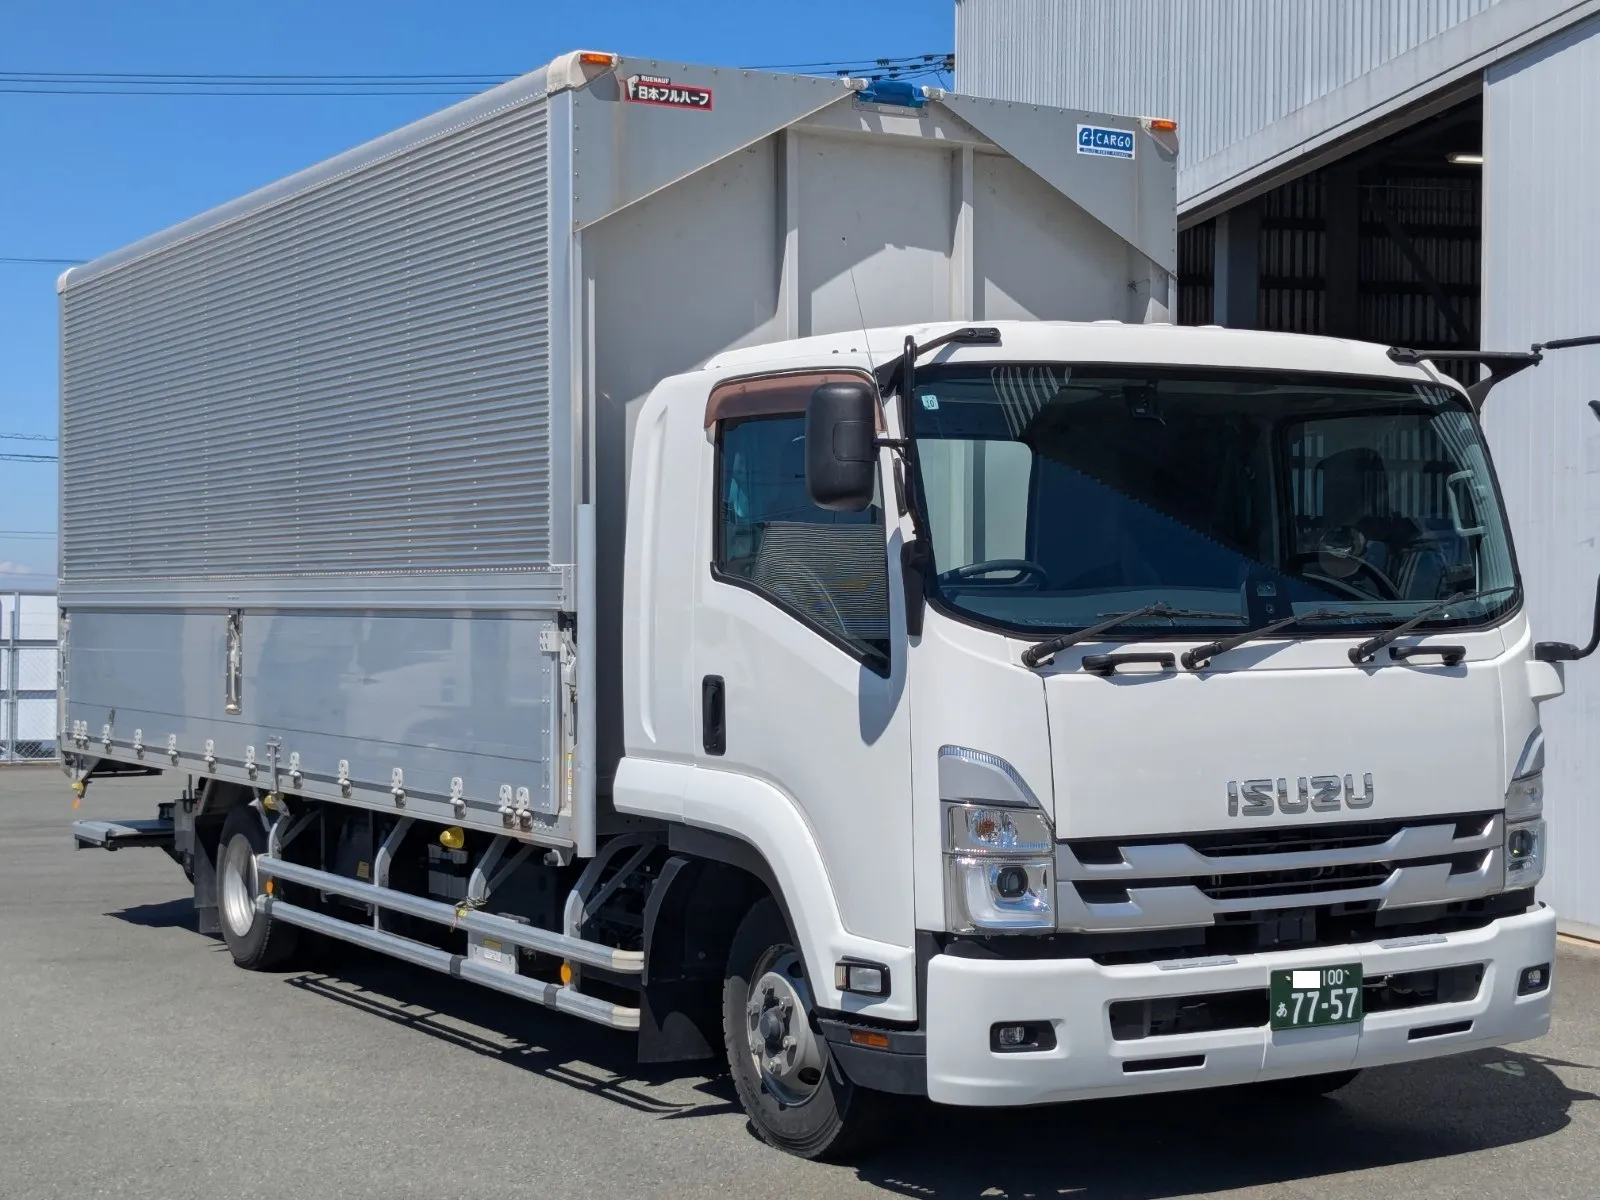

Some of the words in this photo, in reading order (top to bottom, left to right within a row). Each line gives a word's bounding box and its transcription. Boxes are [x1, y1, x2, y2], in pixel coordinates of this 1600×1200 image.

[638, 85, 709, 105] 日本フルハーフ
[1227, 772, 1374, 817] ISUZU
[1322, 969, 1343, 986] 100
[1276, 1001, 1288, 1018] あ
[1291, 987, 1358, 1025] 77-57
